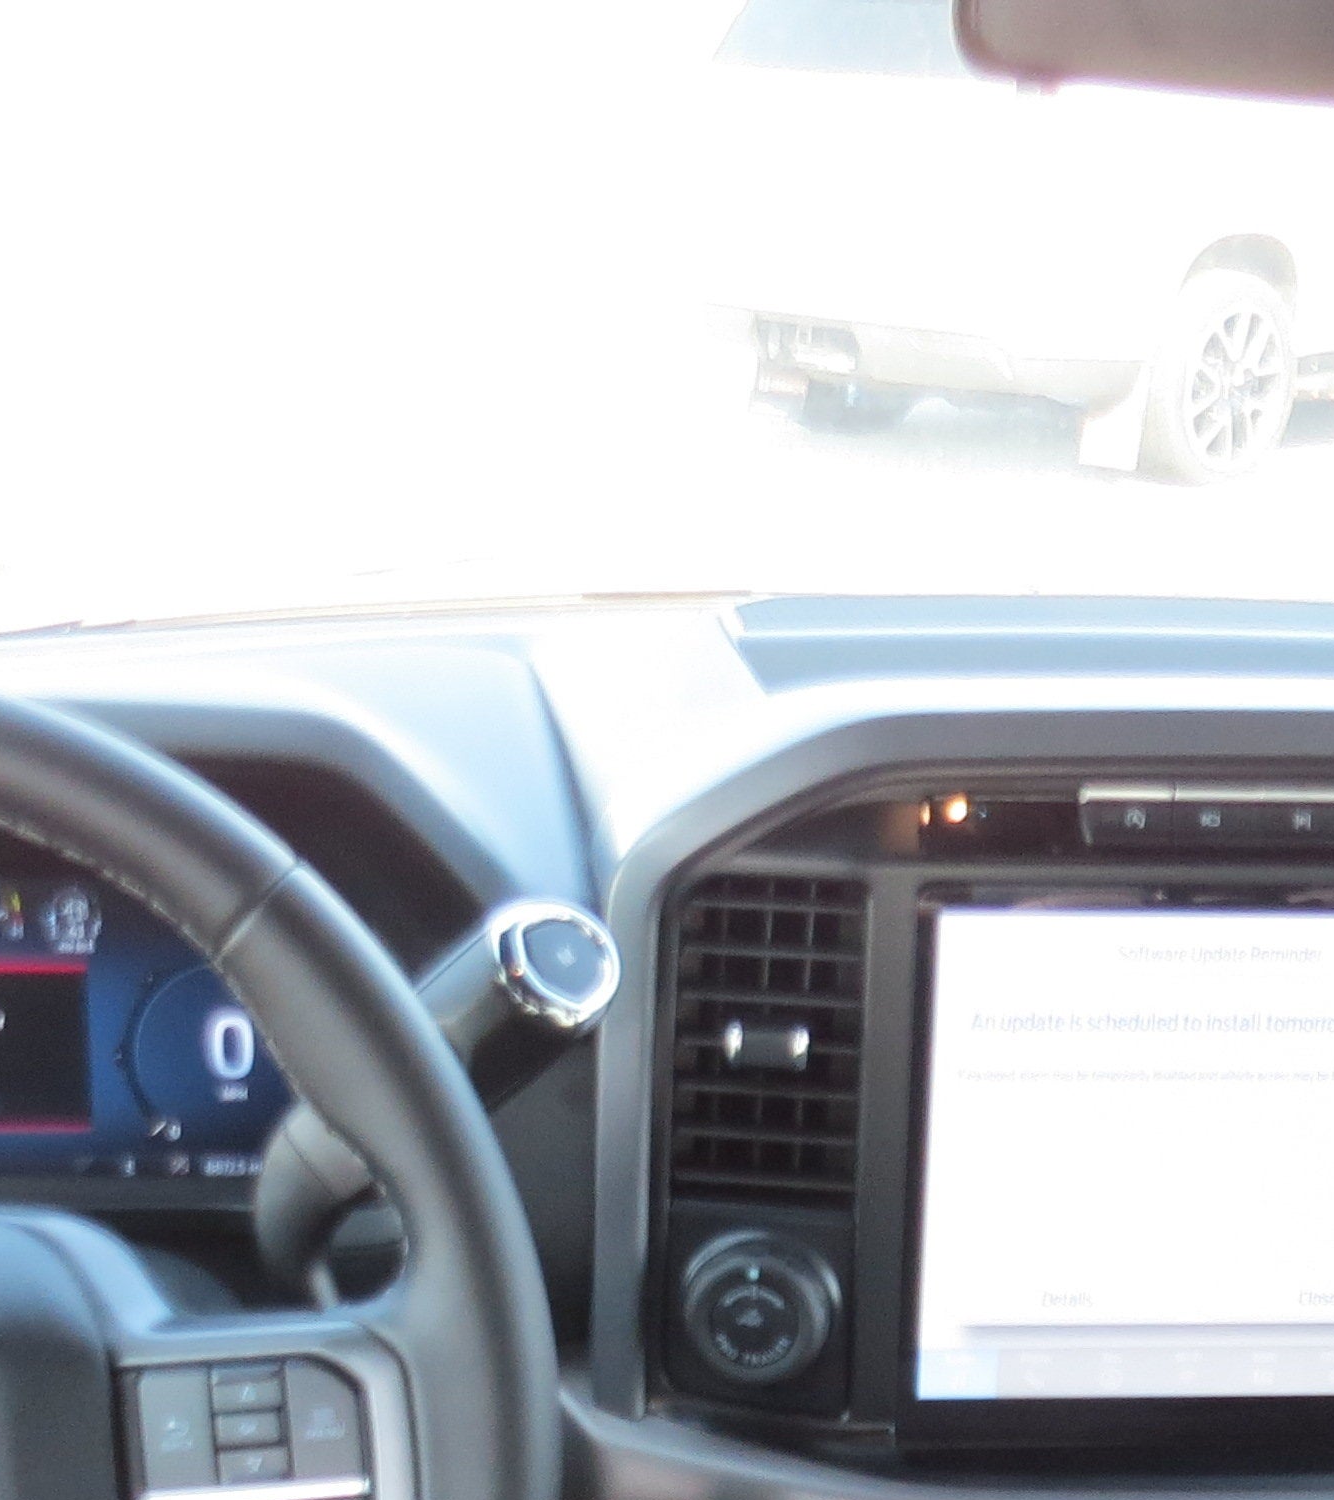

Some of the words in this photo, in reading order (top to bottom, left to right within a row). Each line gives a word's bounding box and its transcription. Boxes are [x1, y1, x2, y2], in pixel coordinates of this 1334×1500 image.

[1191, 944, 1247, 965] Update
[970, 1013, 998, 1032] An
[1000, 1012, 1065, 1035] update
[1087, 1012, 1179, 1032] scheduled
[1183, 1013, 1203, 1032] to
[1206, 1012, 1262, 1032] install
[212, 1014, 255, 1080] 0
